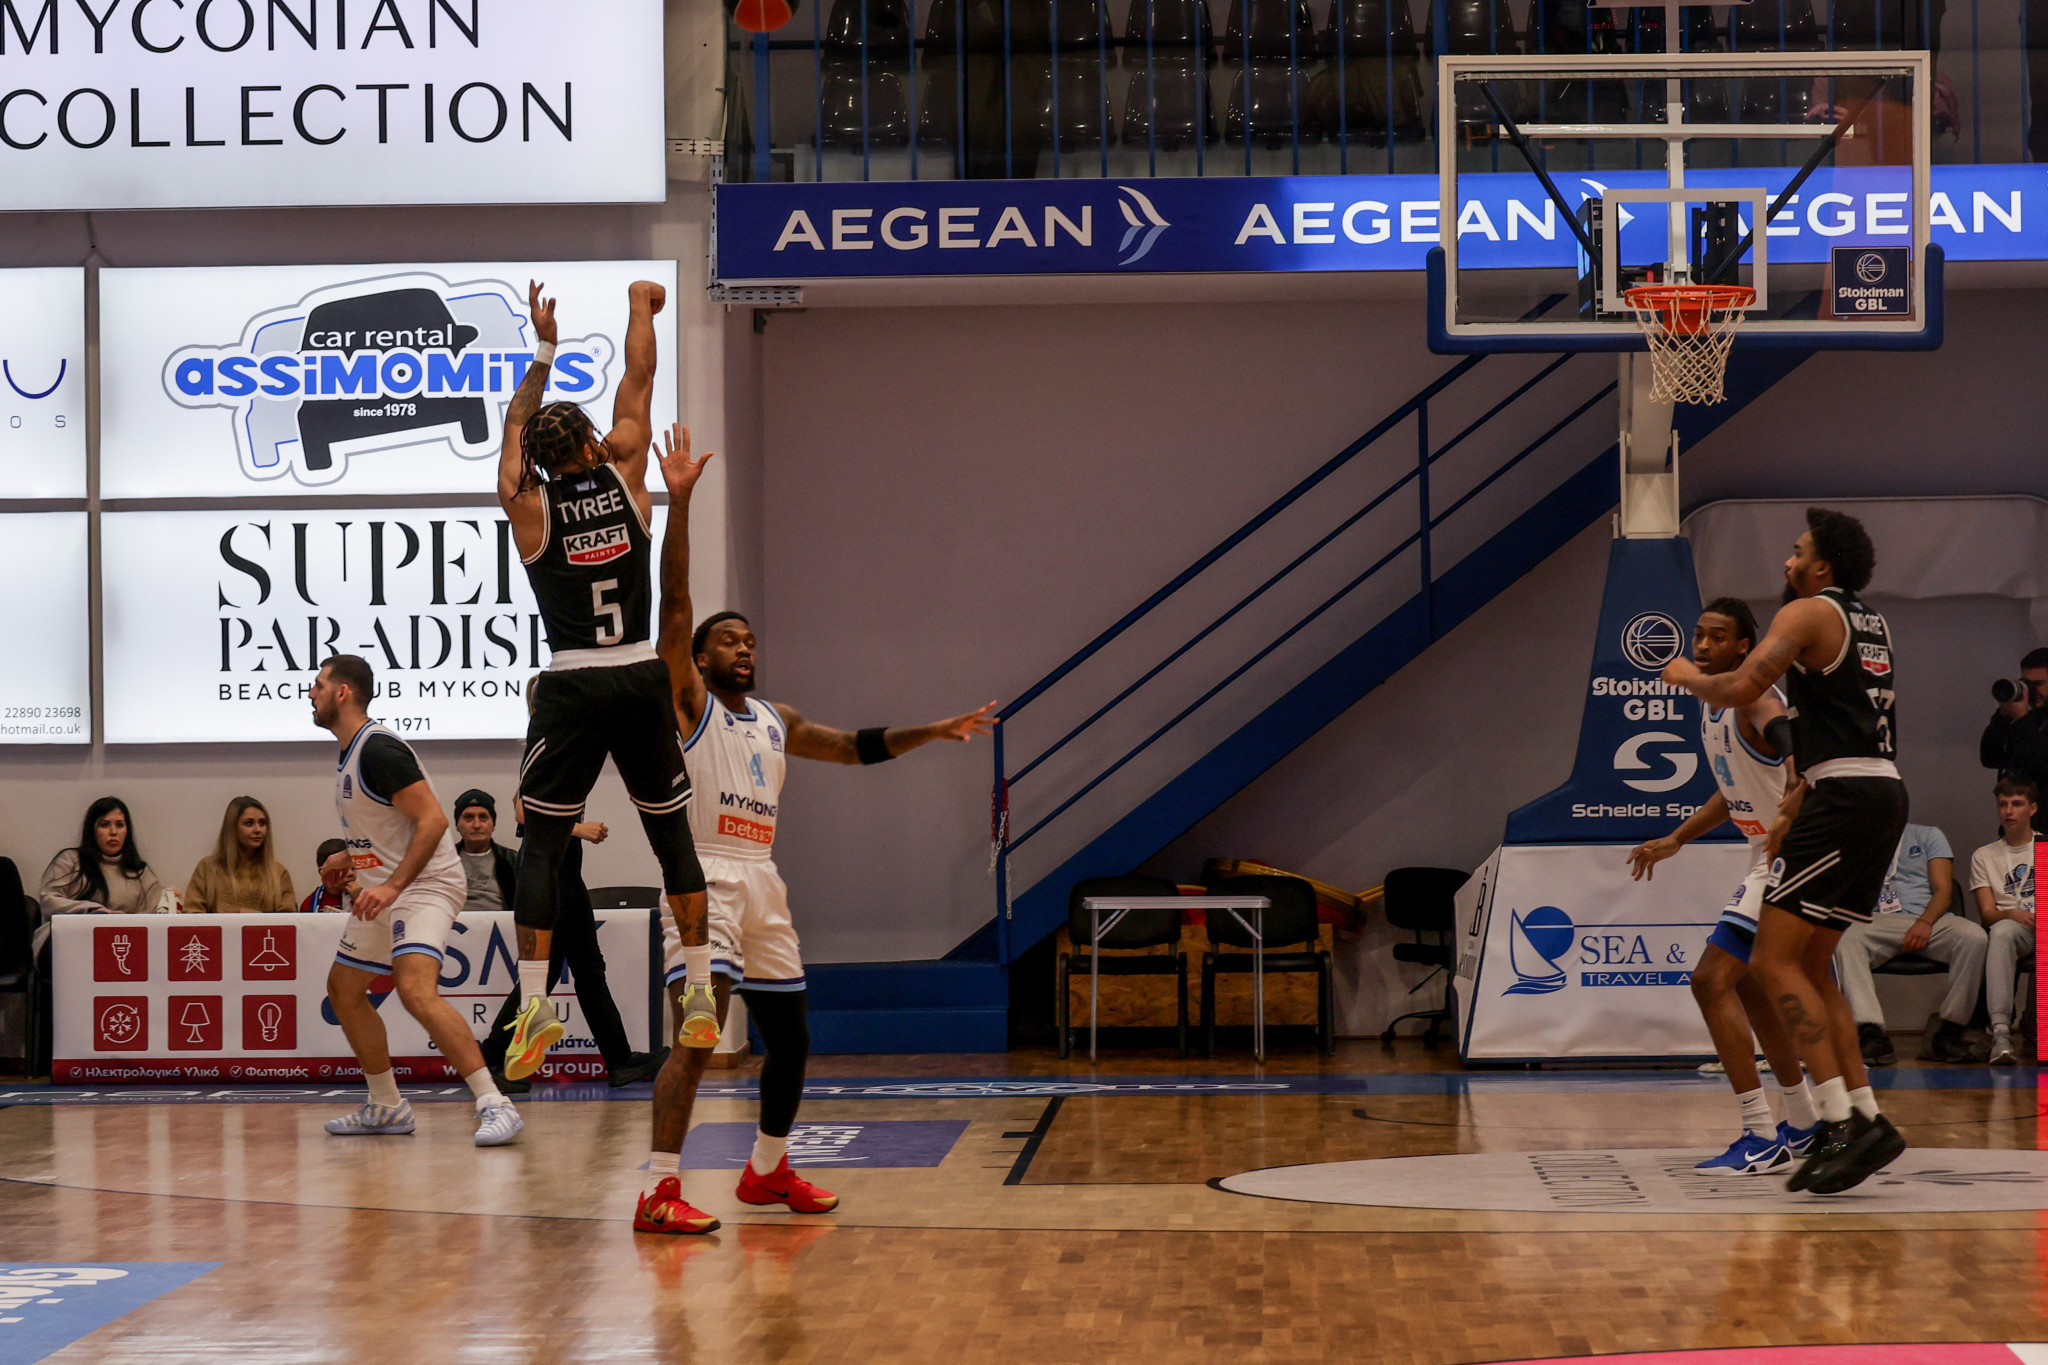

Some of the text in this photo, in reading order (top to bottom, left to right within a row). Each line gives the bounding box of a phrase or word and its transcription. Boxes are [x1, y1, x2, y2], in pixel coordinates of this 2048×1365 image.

[0, 0, 480, 56] MYCONIAN
[0, 81, 573, 150] COLLECTION
[772, 205, 1093, 252] AEGEAN
[1233, 199, 1556, 246] AEGEAN
[1838, 286, 1904, 298] Stoiximan
[1854, 298, 1888, 311] GBL
[309, 324, 453, 349] car rental
[557, 487, 625, 524] TYREE
[565, 525, 626, 553] KRAFT
[584, 547, 617, 561] PAINTS
[590, 577, 625, 647] 5
[218, 682, 311, 701] BEACH
[418, 680, 521, 699] MYKON
[1592, 676, 1693, 696] Stoixim
[4, 706, 82, 718] 22890 23698
[1623, 699, 1684, 721] GBL
[394, 717, 431, 731] 1971
[1571, 803, 1662, 818] Schelde
[1580, 935, 1687, 965] SEA &
[1586, 972, 1668, 985] TRAVEL
[85, 1066, 181, 1079] Ηλεκτρολογικό
[184, 1066, 220, 1077] Υλικό
[245, 1065, 309, 1079] Φωτισμός
